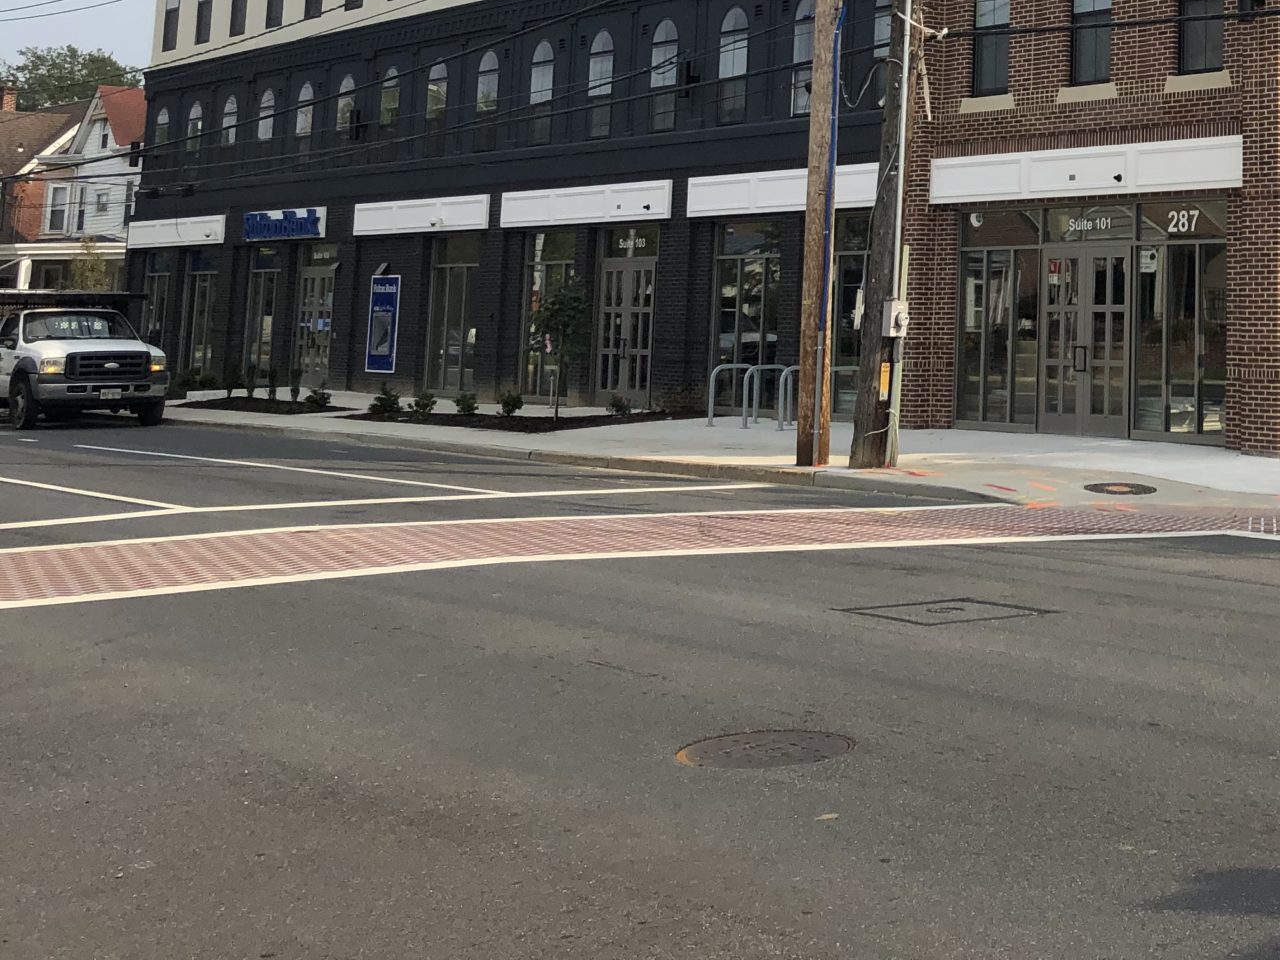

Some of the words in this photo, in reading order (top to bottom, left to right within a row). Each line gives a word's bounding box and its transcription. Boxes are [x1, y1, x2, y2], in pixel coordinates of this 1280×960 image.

[1068, 218, 1093, 231] Suite
[1095, 217, 1112, 230] 101
[1168, 210, 1200, 233] 287
[618, 238, 634, 248] Suite
[635, 238, 646, 248] 103
